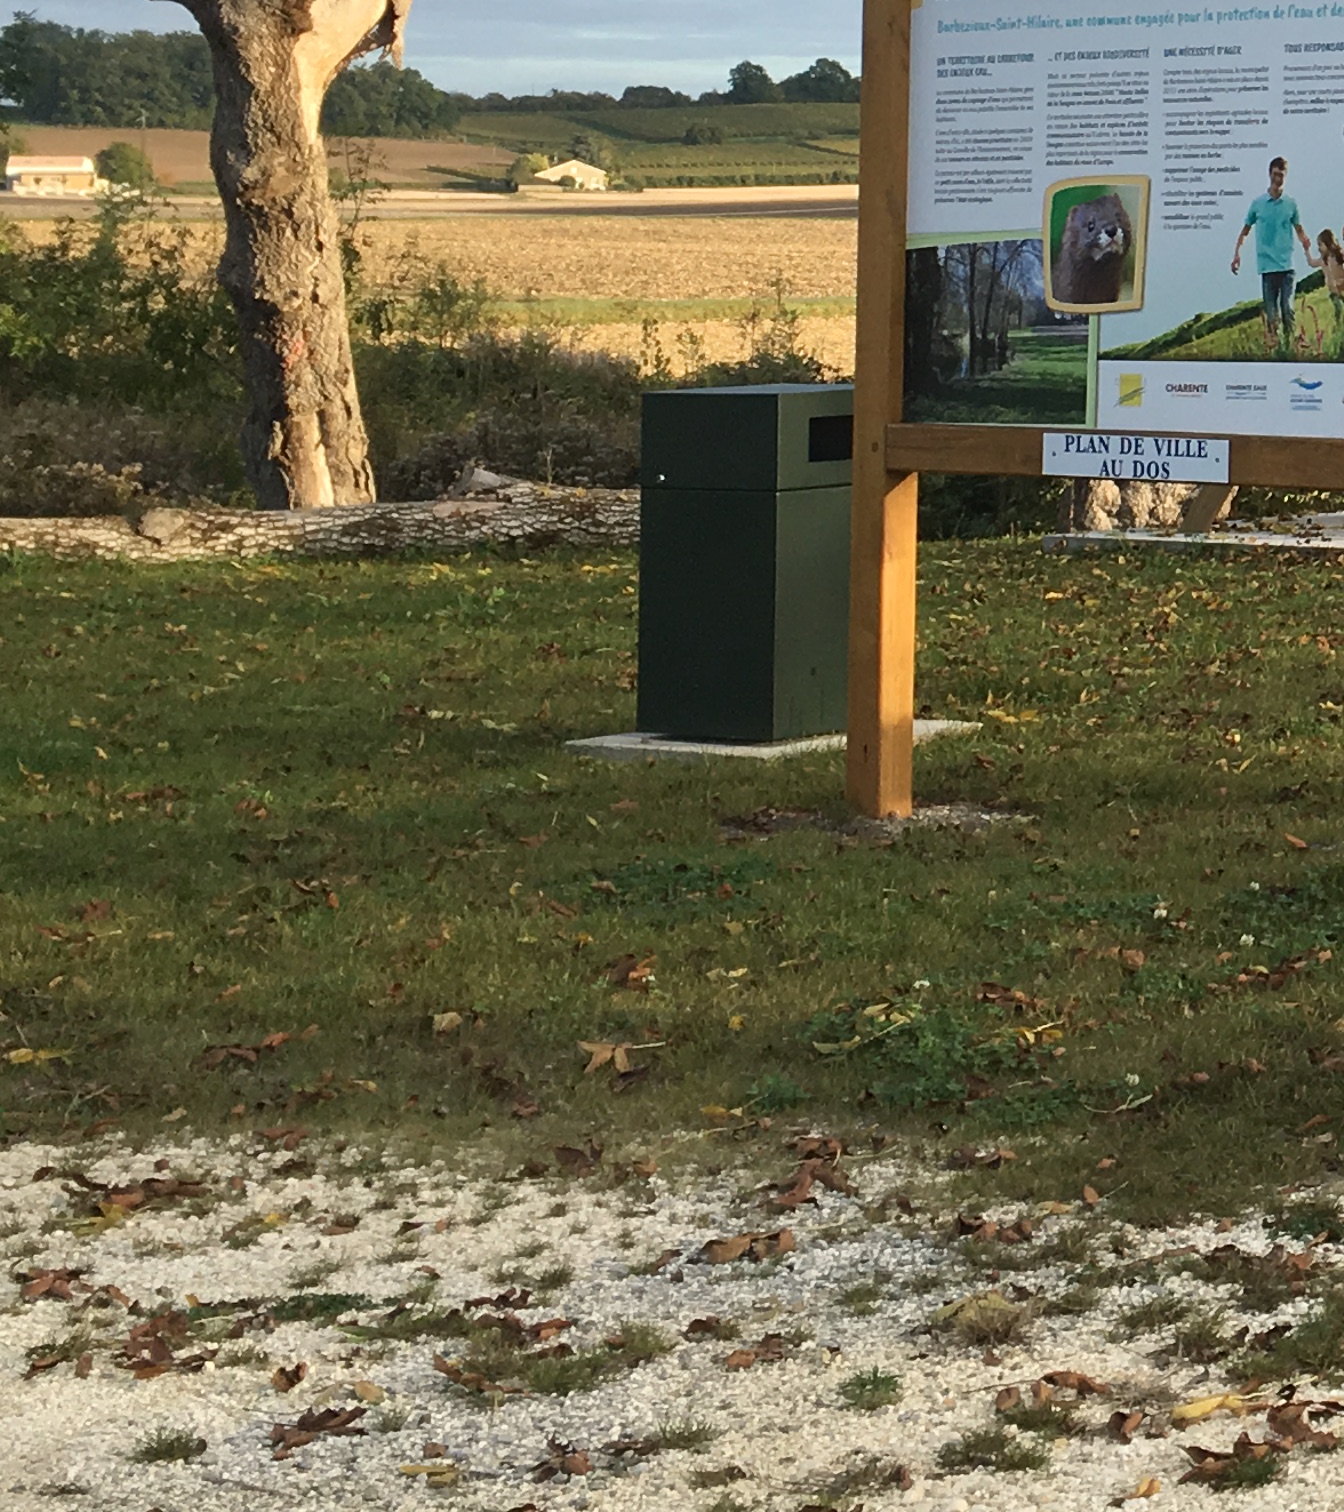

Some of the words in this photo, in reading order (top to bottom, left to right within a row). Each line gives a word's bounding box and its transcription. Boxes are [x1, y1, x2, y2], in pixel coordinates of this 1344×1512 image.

[1065, 17, 1084, 28] une
[1086, 15, 1132, 27] commune
[1134, 9, 1175, 28] engagée
[1178, 11, 1201, 26] pour
[1203, 8, 1213, 22] la
[1216, 5, 1270, 25] protection
[1273, 5, 1285, 20] de
[1287, 3, 1313, 18] l'eau
[1316, 4, 1328, 17] et
[1165, 384, 1208, 394] CHARENTE
[1064, 435, 1110, 454] PLAN
[1119, 437, 1144, 455] DE
[1154, 438, 1208, 458] VILLE
[1099, 459, 1123, 477] AU
[1132, 460, 1170, 479] DOS
